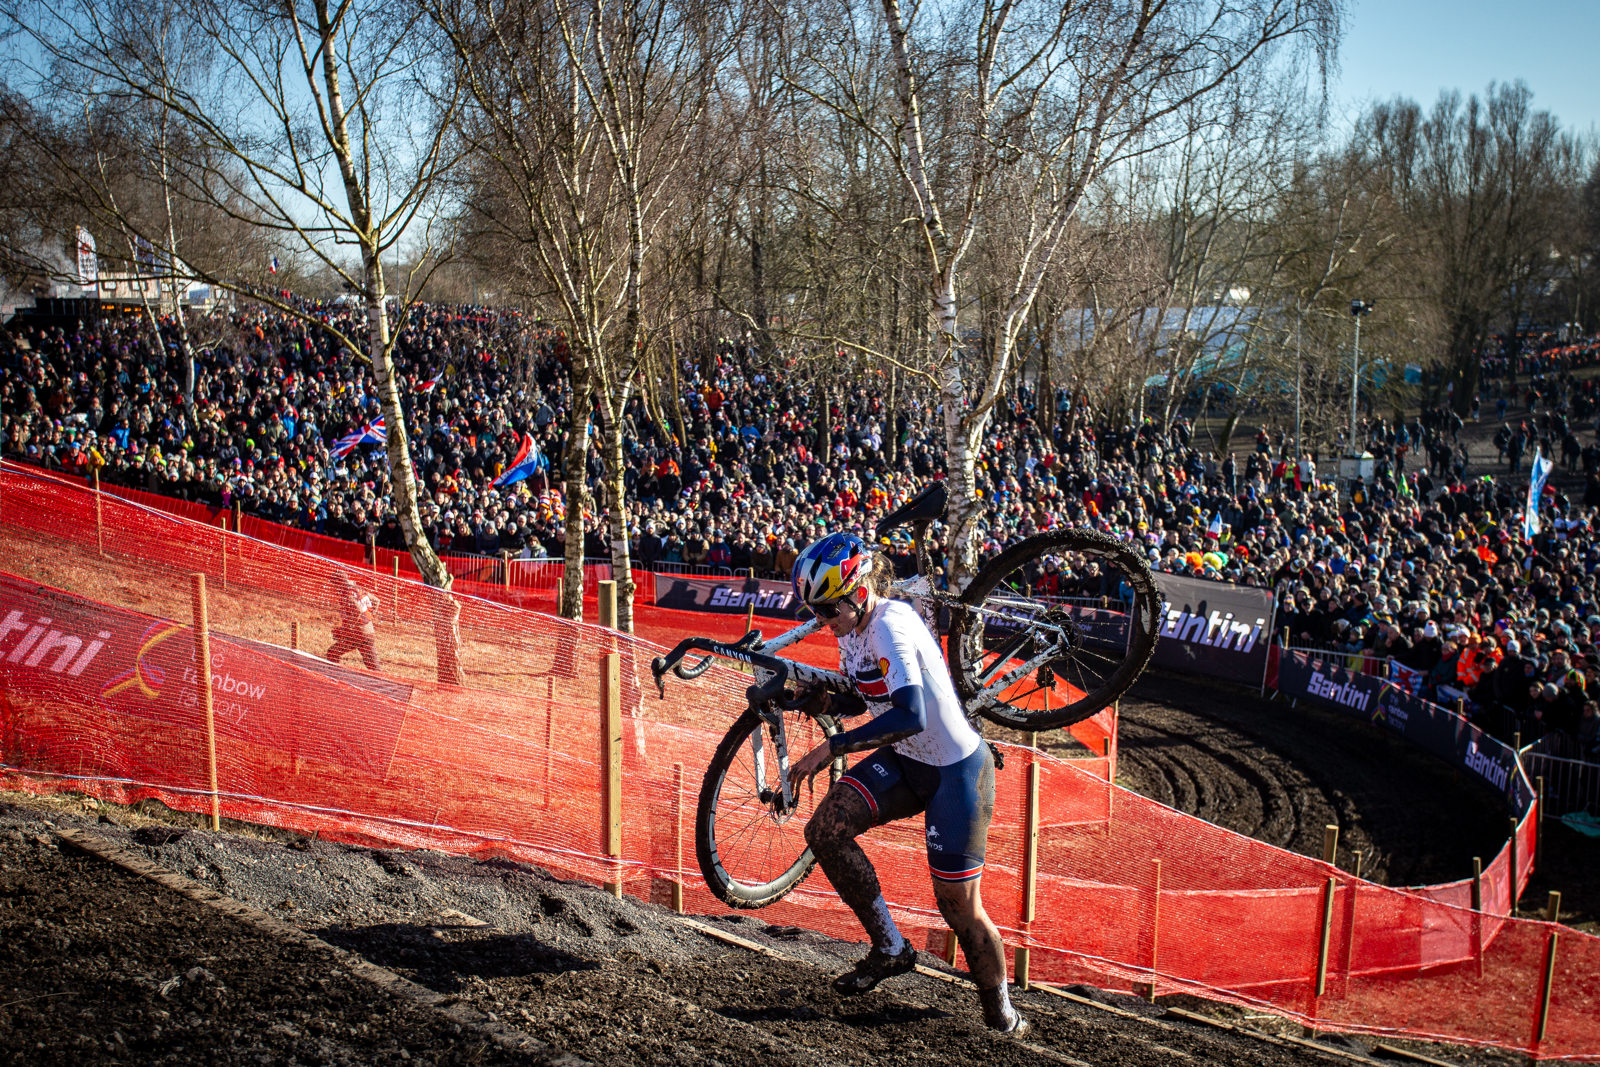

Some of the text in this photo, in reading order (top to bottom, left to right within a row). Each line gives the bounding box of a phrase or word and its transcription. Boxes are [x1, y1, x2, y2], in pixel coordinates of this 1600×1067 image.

[710, 587, 794, 609] Santini
[713, 645, 752, 664] CANYON
[184, 667, 266, 700] ranbow
[1307, 671, 1372, 711] Santini
[1464, 741, 1510, 792] Santini
